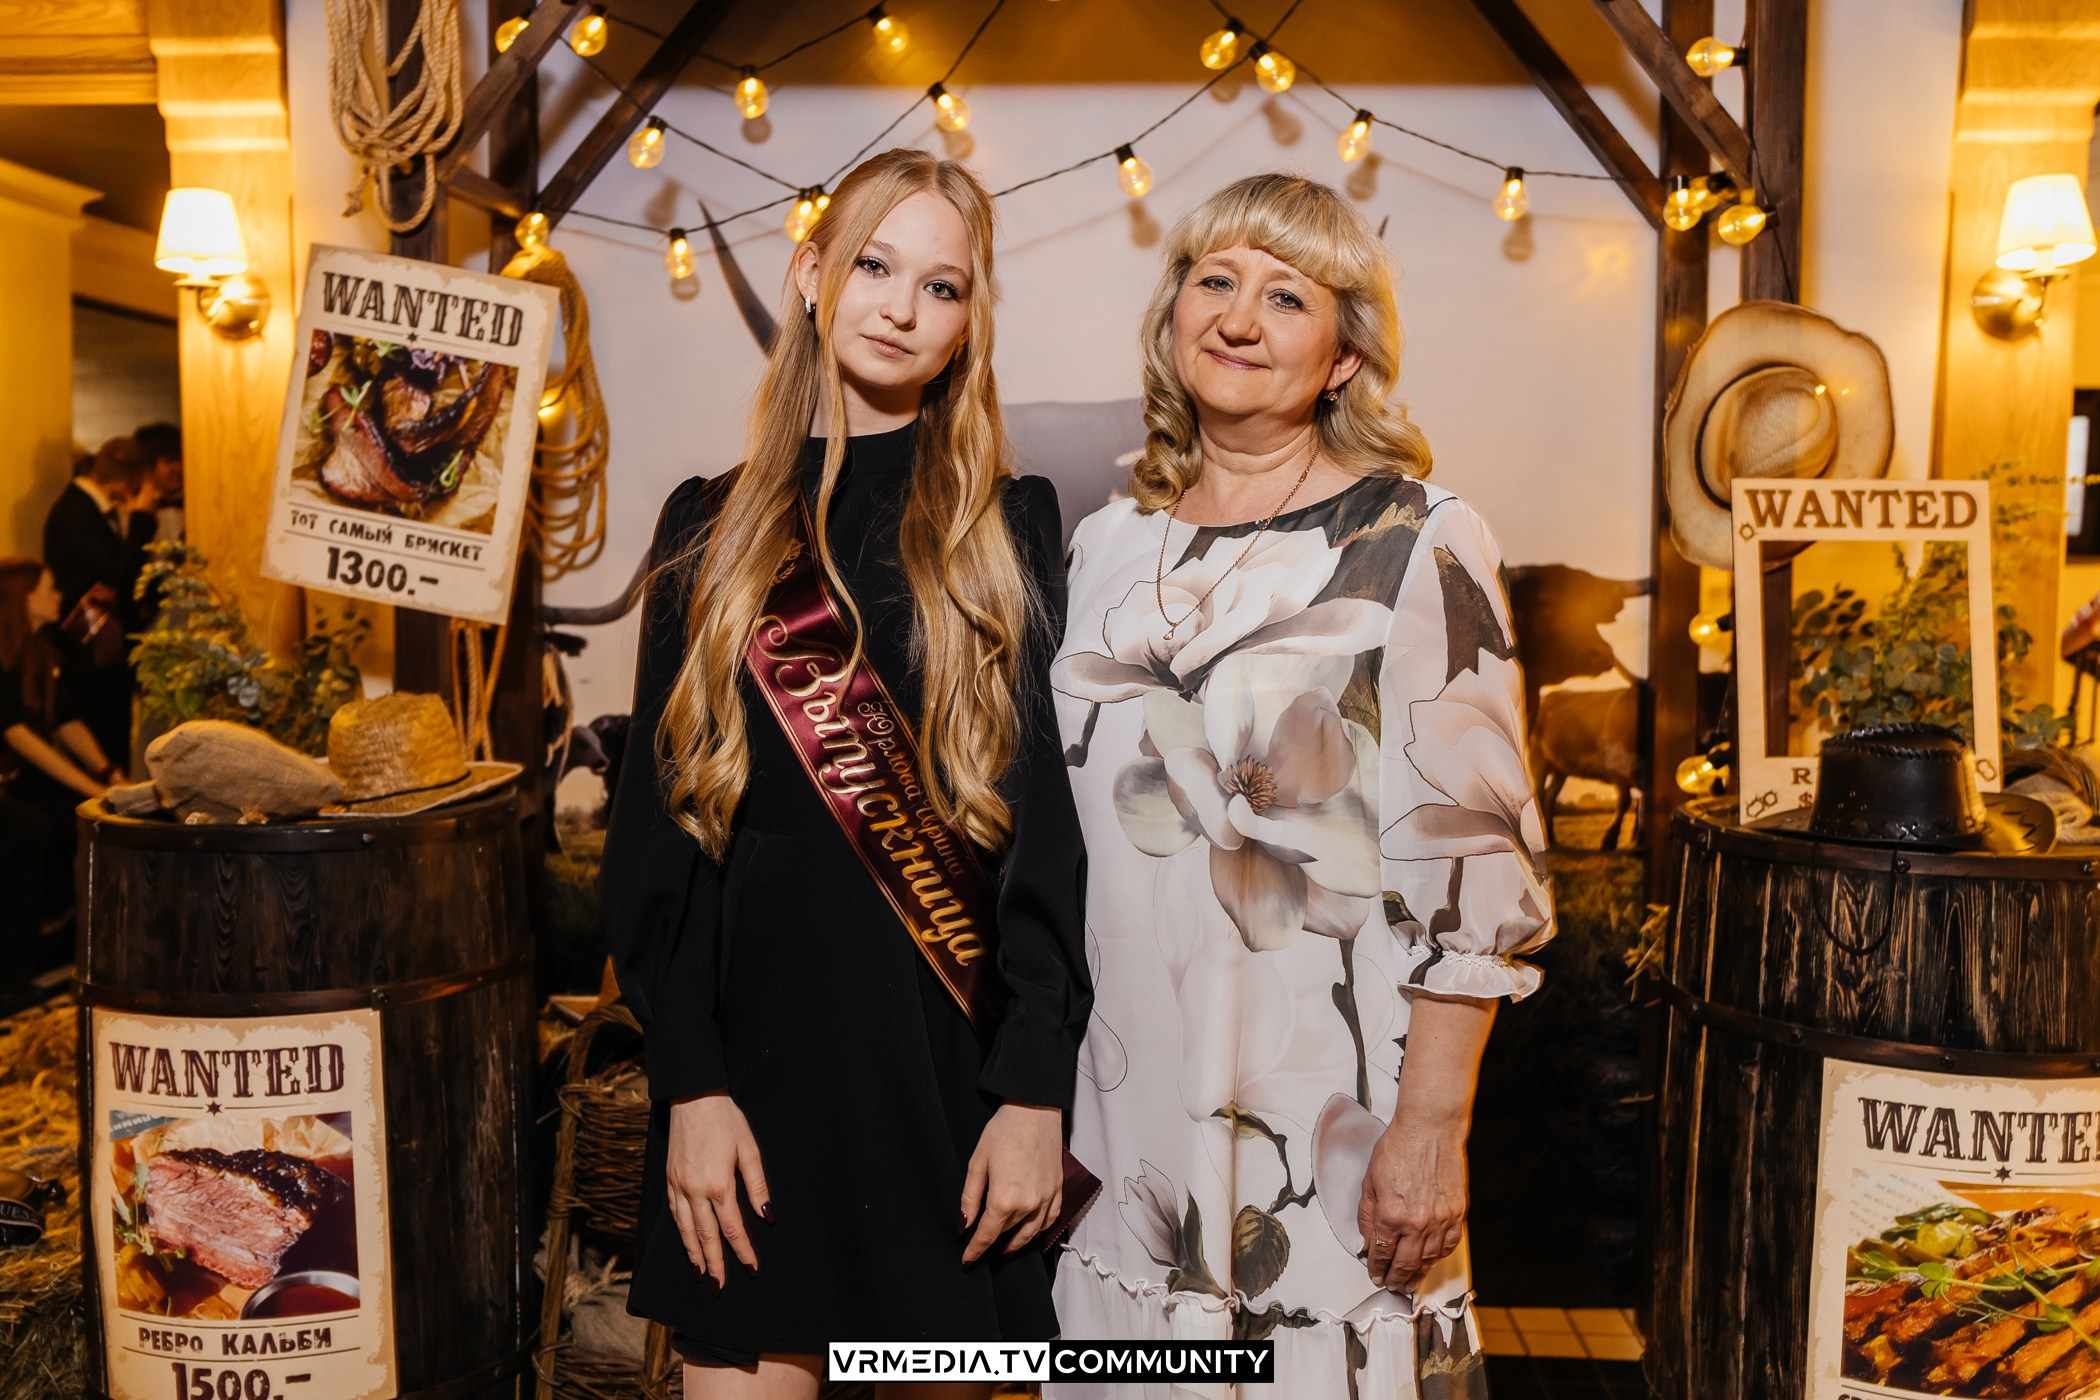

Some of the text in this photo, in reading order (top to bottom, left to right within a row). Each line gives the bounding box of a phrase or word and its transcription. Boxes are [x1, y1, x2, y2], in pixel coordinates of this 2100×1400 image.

[322, 271, 525, 347] WANTED
[1744, 488, 1978, 529] WANTED
[329, 518, 393, 545] САМЫЙ
[405, 534, 483, 562] БРИСКЕТ
[857, 701, 924, 801] Юрлова
[755, 614, 987, 967] Выпускница
[109, 1041, 346, 1098] WANTED
[1857, 1097, 2100, 1164] WANTE
[138, 1327, 332, 1356] РЕБРО КАЛЬБИ
